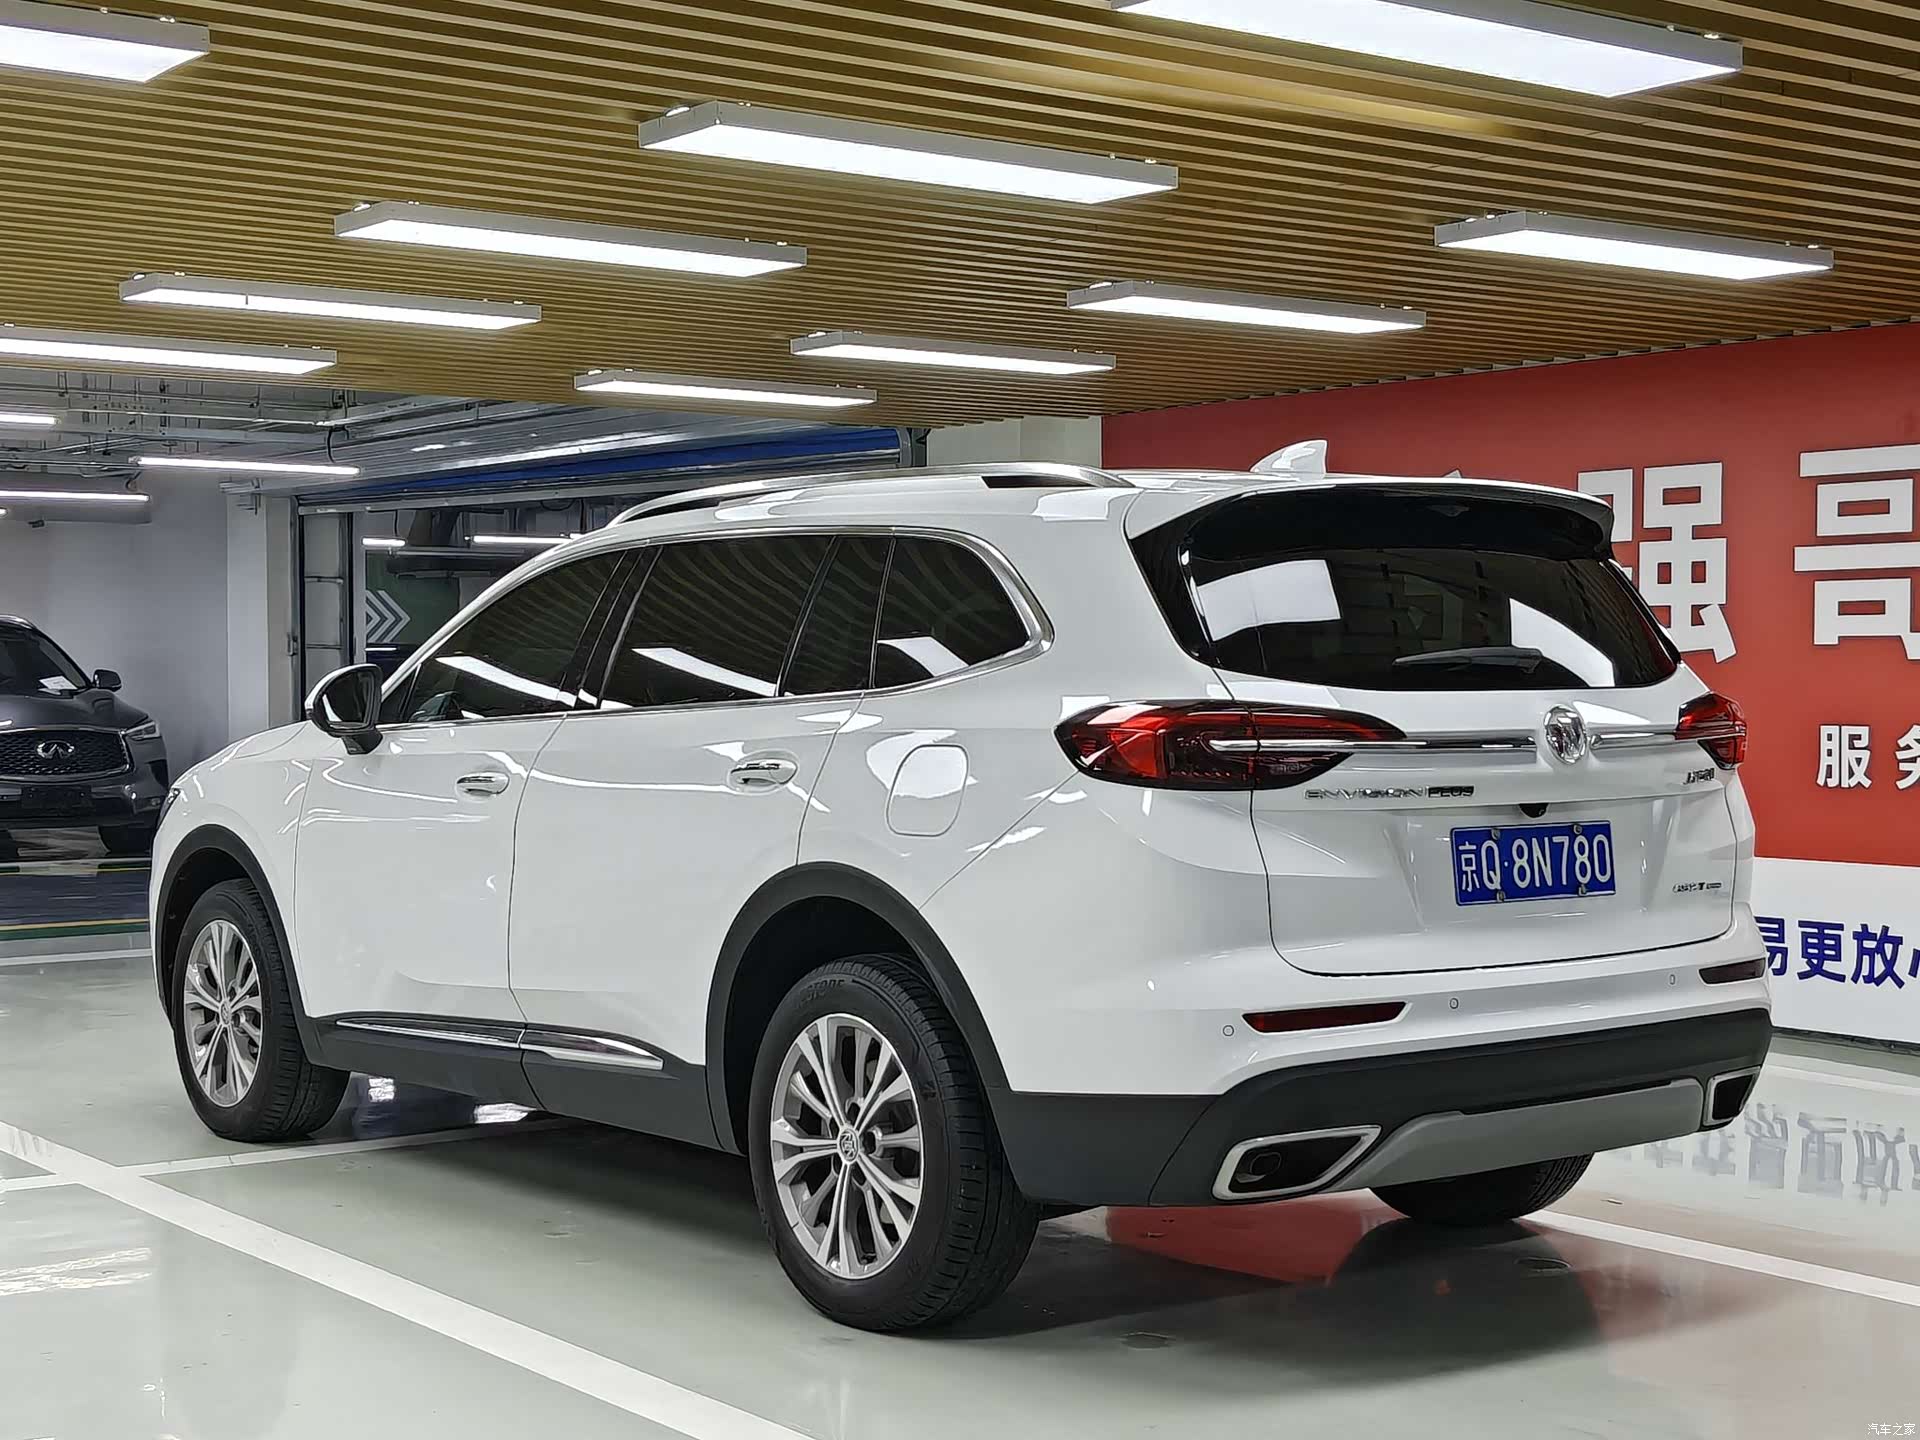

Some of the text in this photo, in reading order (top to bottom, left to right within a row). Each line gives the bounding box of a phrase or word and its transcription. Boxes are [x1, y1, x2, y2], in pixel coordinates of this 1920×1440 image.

[1458, 833, 1612, 893] 京Q·8N780
[1753, 915, 1920, 990] 易更放
